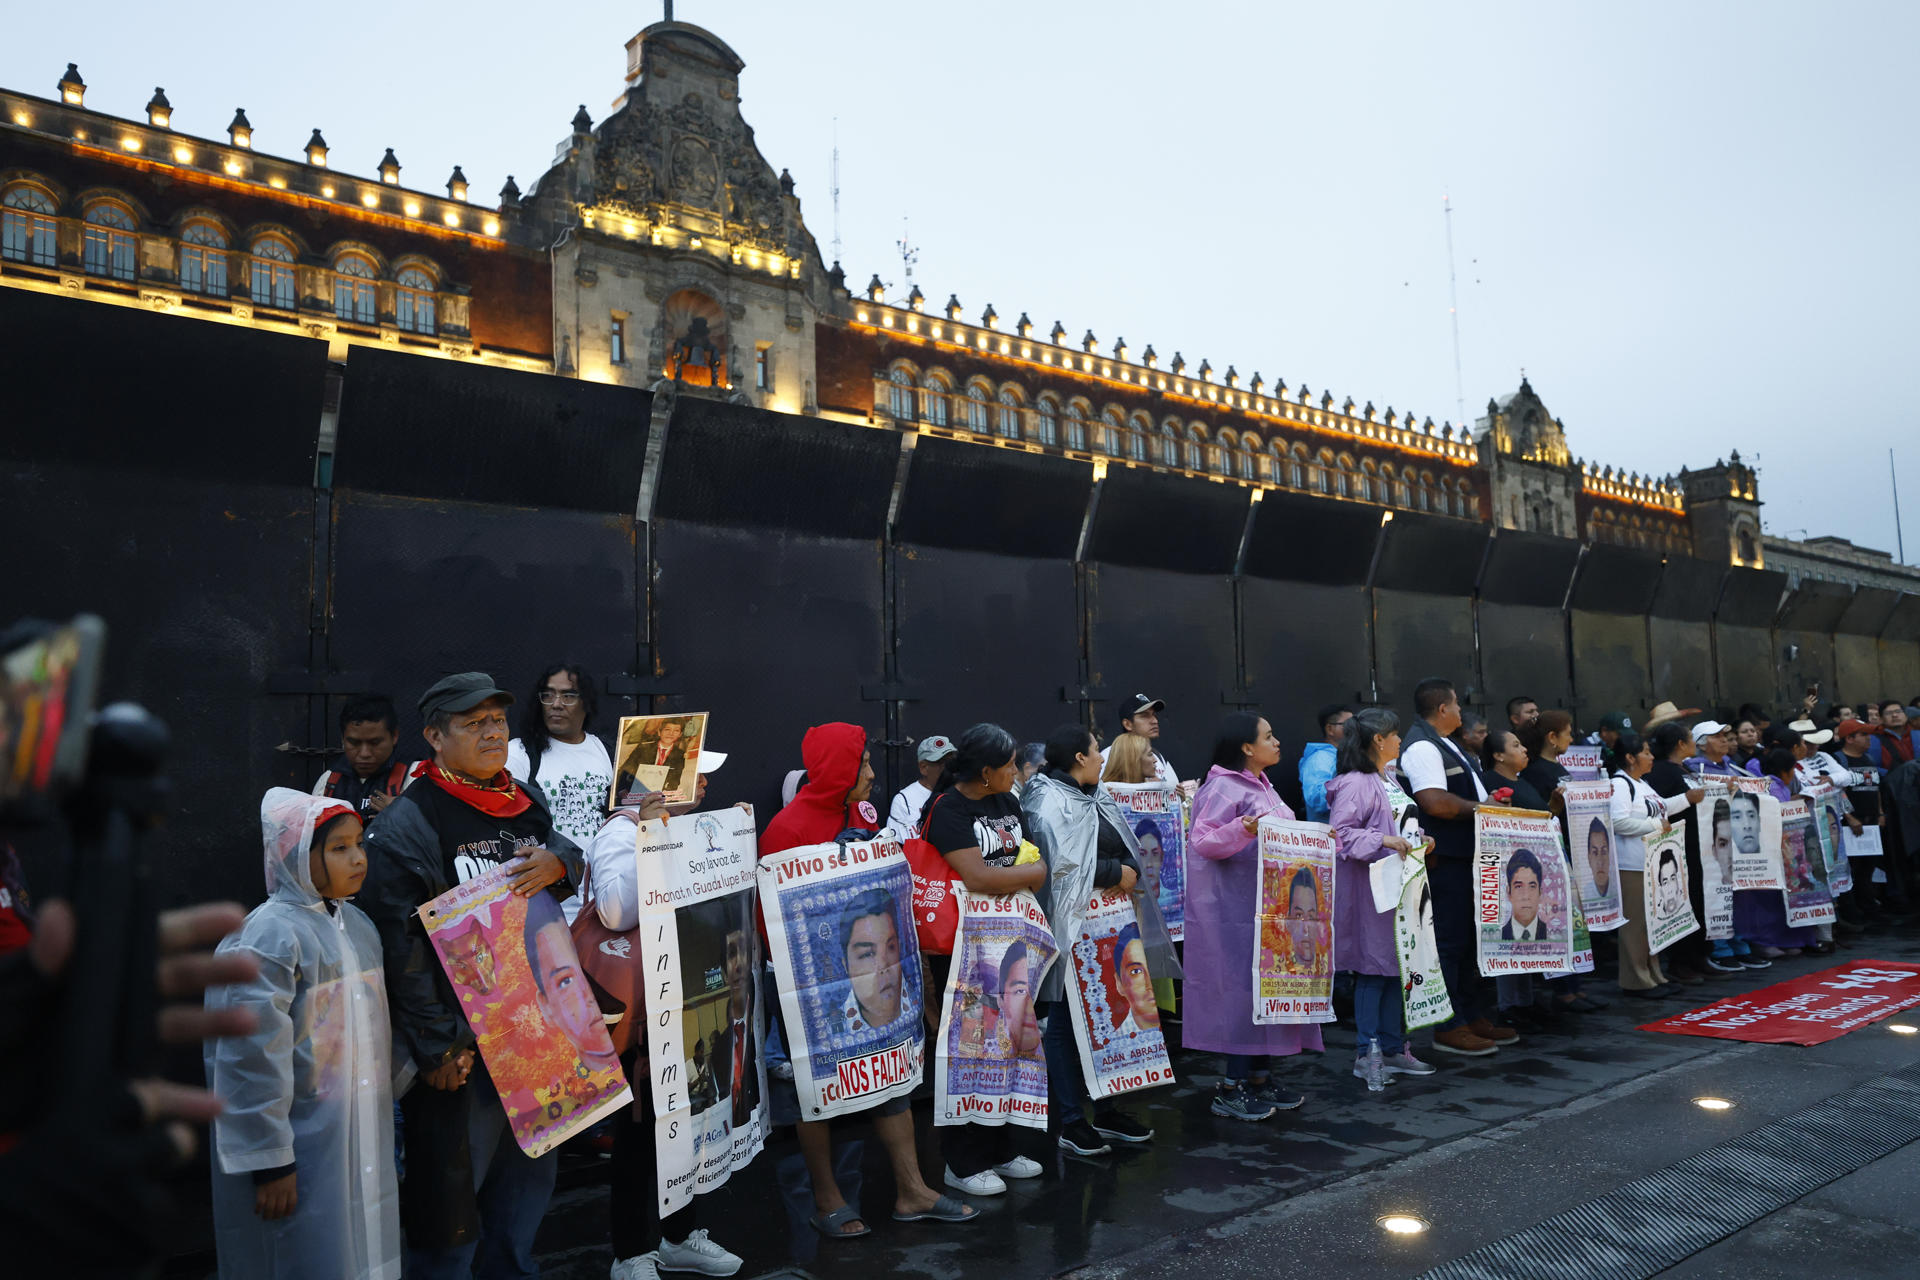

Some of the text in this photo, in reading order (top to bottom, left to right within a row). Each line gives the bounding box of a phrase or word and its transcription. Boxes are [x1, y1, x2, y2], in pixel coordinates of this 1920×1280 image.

[1480, 816, 1502, 830] ¡Vivo
[1503, 820, 1511, 829] se
[1281, 833, 1290, 844] se
[1291, 832, 1300, 846] lo
[688, 861, 706, 876] Soy
[713, 855, 730, 869] voz
[776, 857, 824, 885] ¡Vivo
[850, 847, 869, 865] lo
[1481, 866, 1500, 904] FALTAN
[995, 898, 1013, 914] se
[1810, 908, 1828, 919] VIDA
[1482, 907, 1500, 924] NOS
[1487, 957, 1509, 972] ¡Vivo
[1510, 958, 1519, 969] lo
[1520, 957, 1565, 971] queremos!
[1265, 999, 1290, 1016] ¡Vivo
[1293, 999, 1302, 1012] lo
[1681, 1008, 1720, 1023] años
[1698, 993, 1829, 1030] Nos siguen
[1787, 994, 1890, 1023] Faltando
[1102, 1051, 1125, 1066] ADÁN
[838, 1058, 870, 1097] NOS
[870, 1047, 910, 1089] FALTAN
[962, 1071, 1004, 1083] ANTONIO
[1107, 1074, 1143, 1095] ¡Vivo
[1145, 1069, 1160, 1084] lo
[956, 1095, 993, 1117] ¡Vivo
[998, 1098, 1009, 1112] lo
[731, 1148, 748, 1162] 2018
